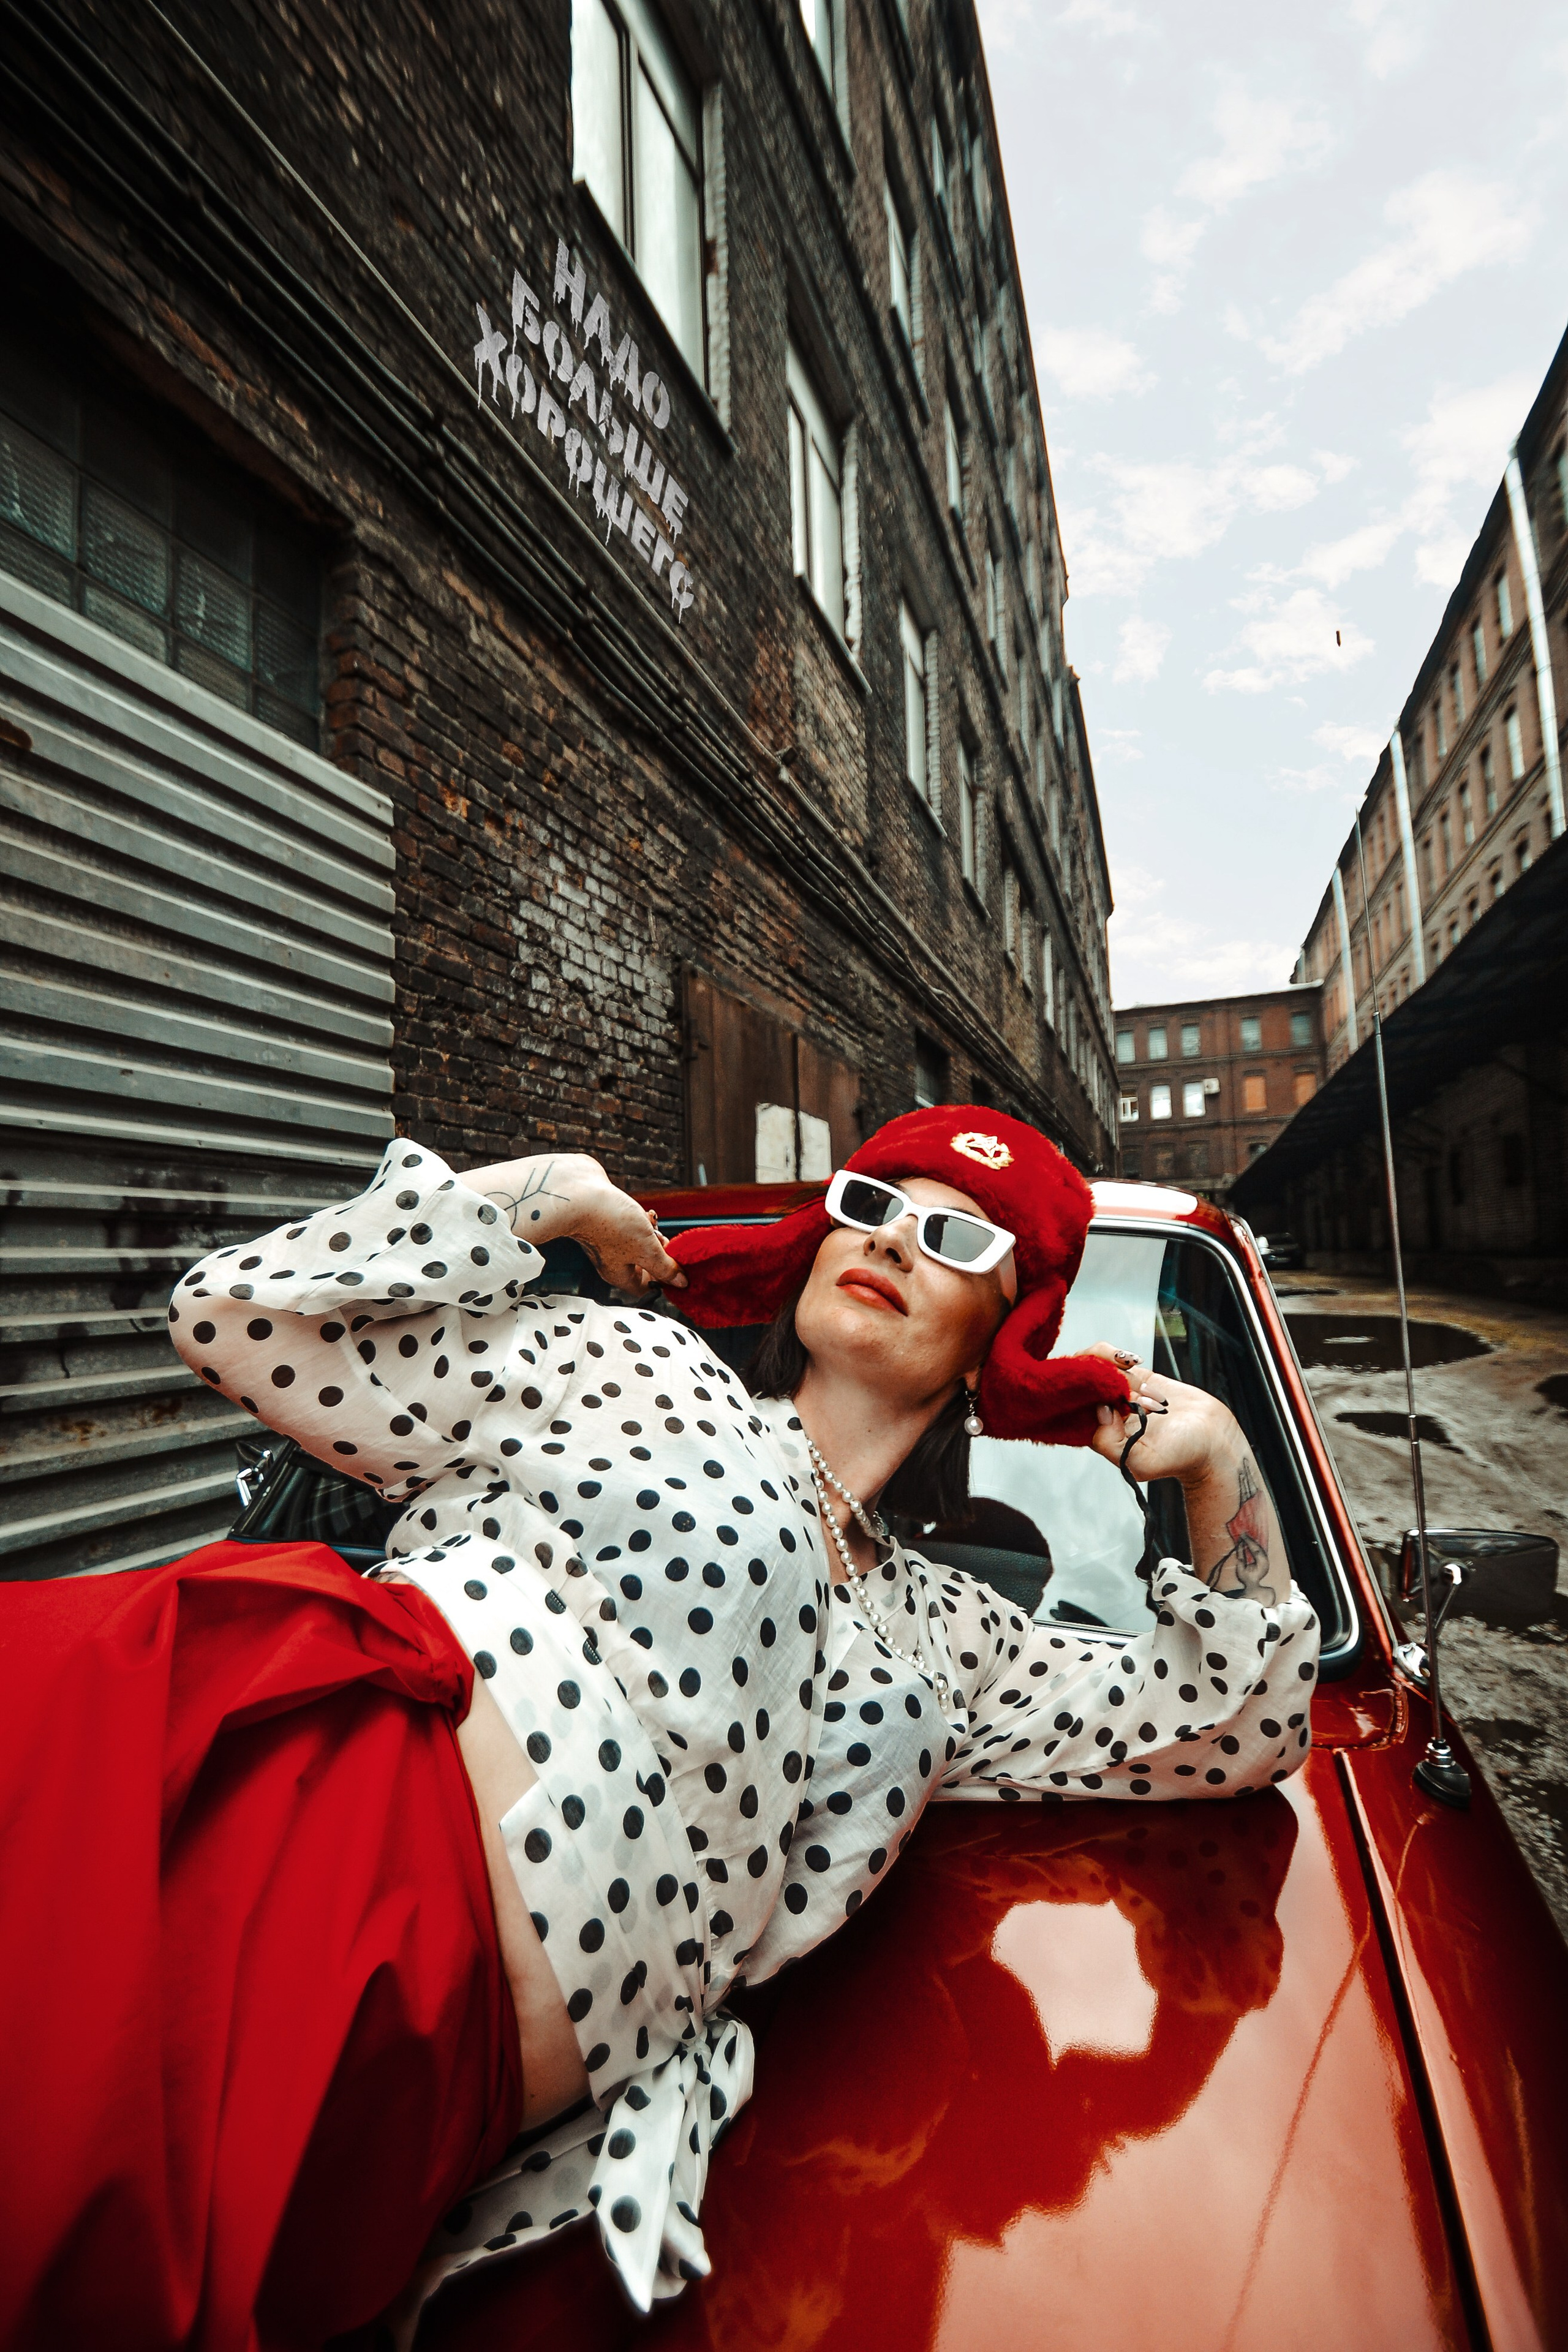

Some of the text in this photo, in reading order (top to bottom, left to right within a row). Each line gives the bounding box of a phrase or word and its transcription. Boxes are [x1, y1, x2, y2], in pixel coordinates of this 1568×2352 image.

[474, 303, 694, 624] ХОРОШЕГО
[511, 268, 689, 544] БОЛЬШЕ
[553, 238, 671, 429] НАДО
